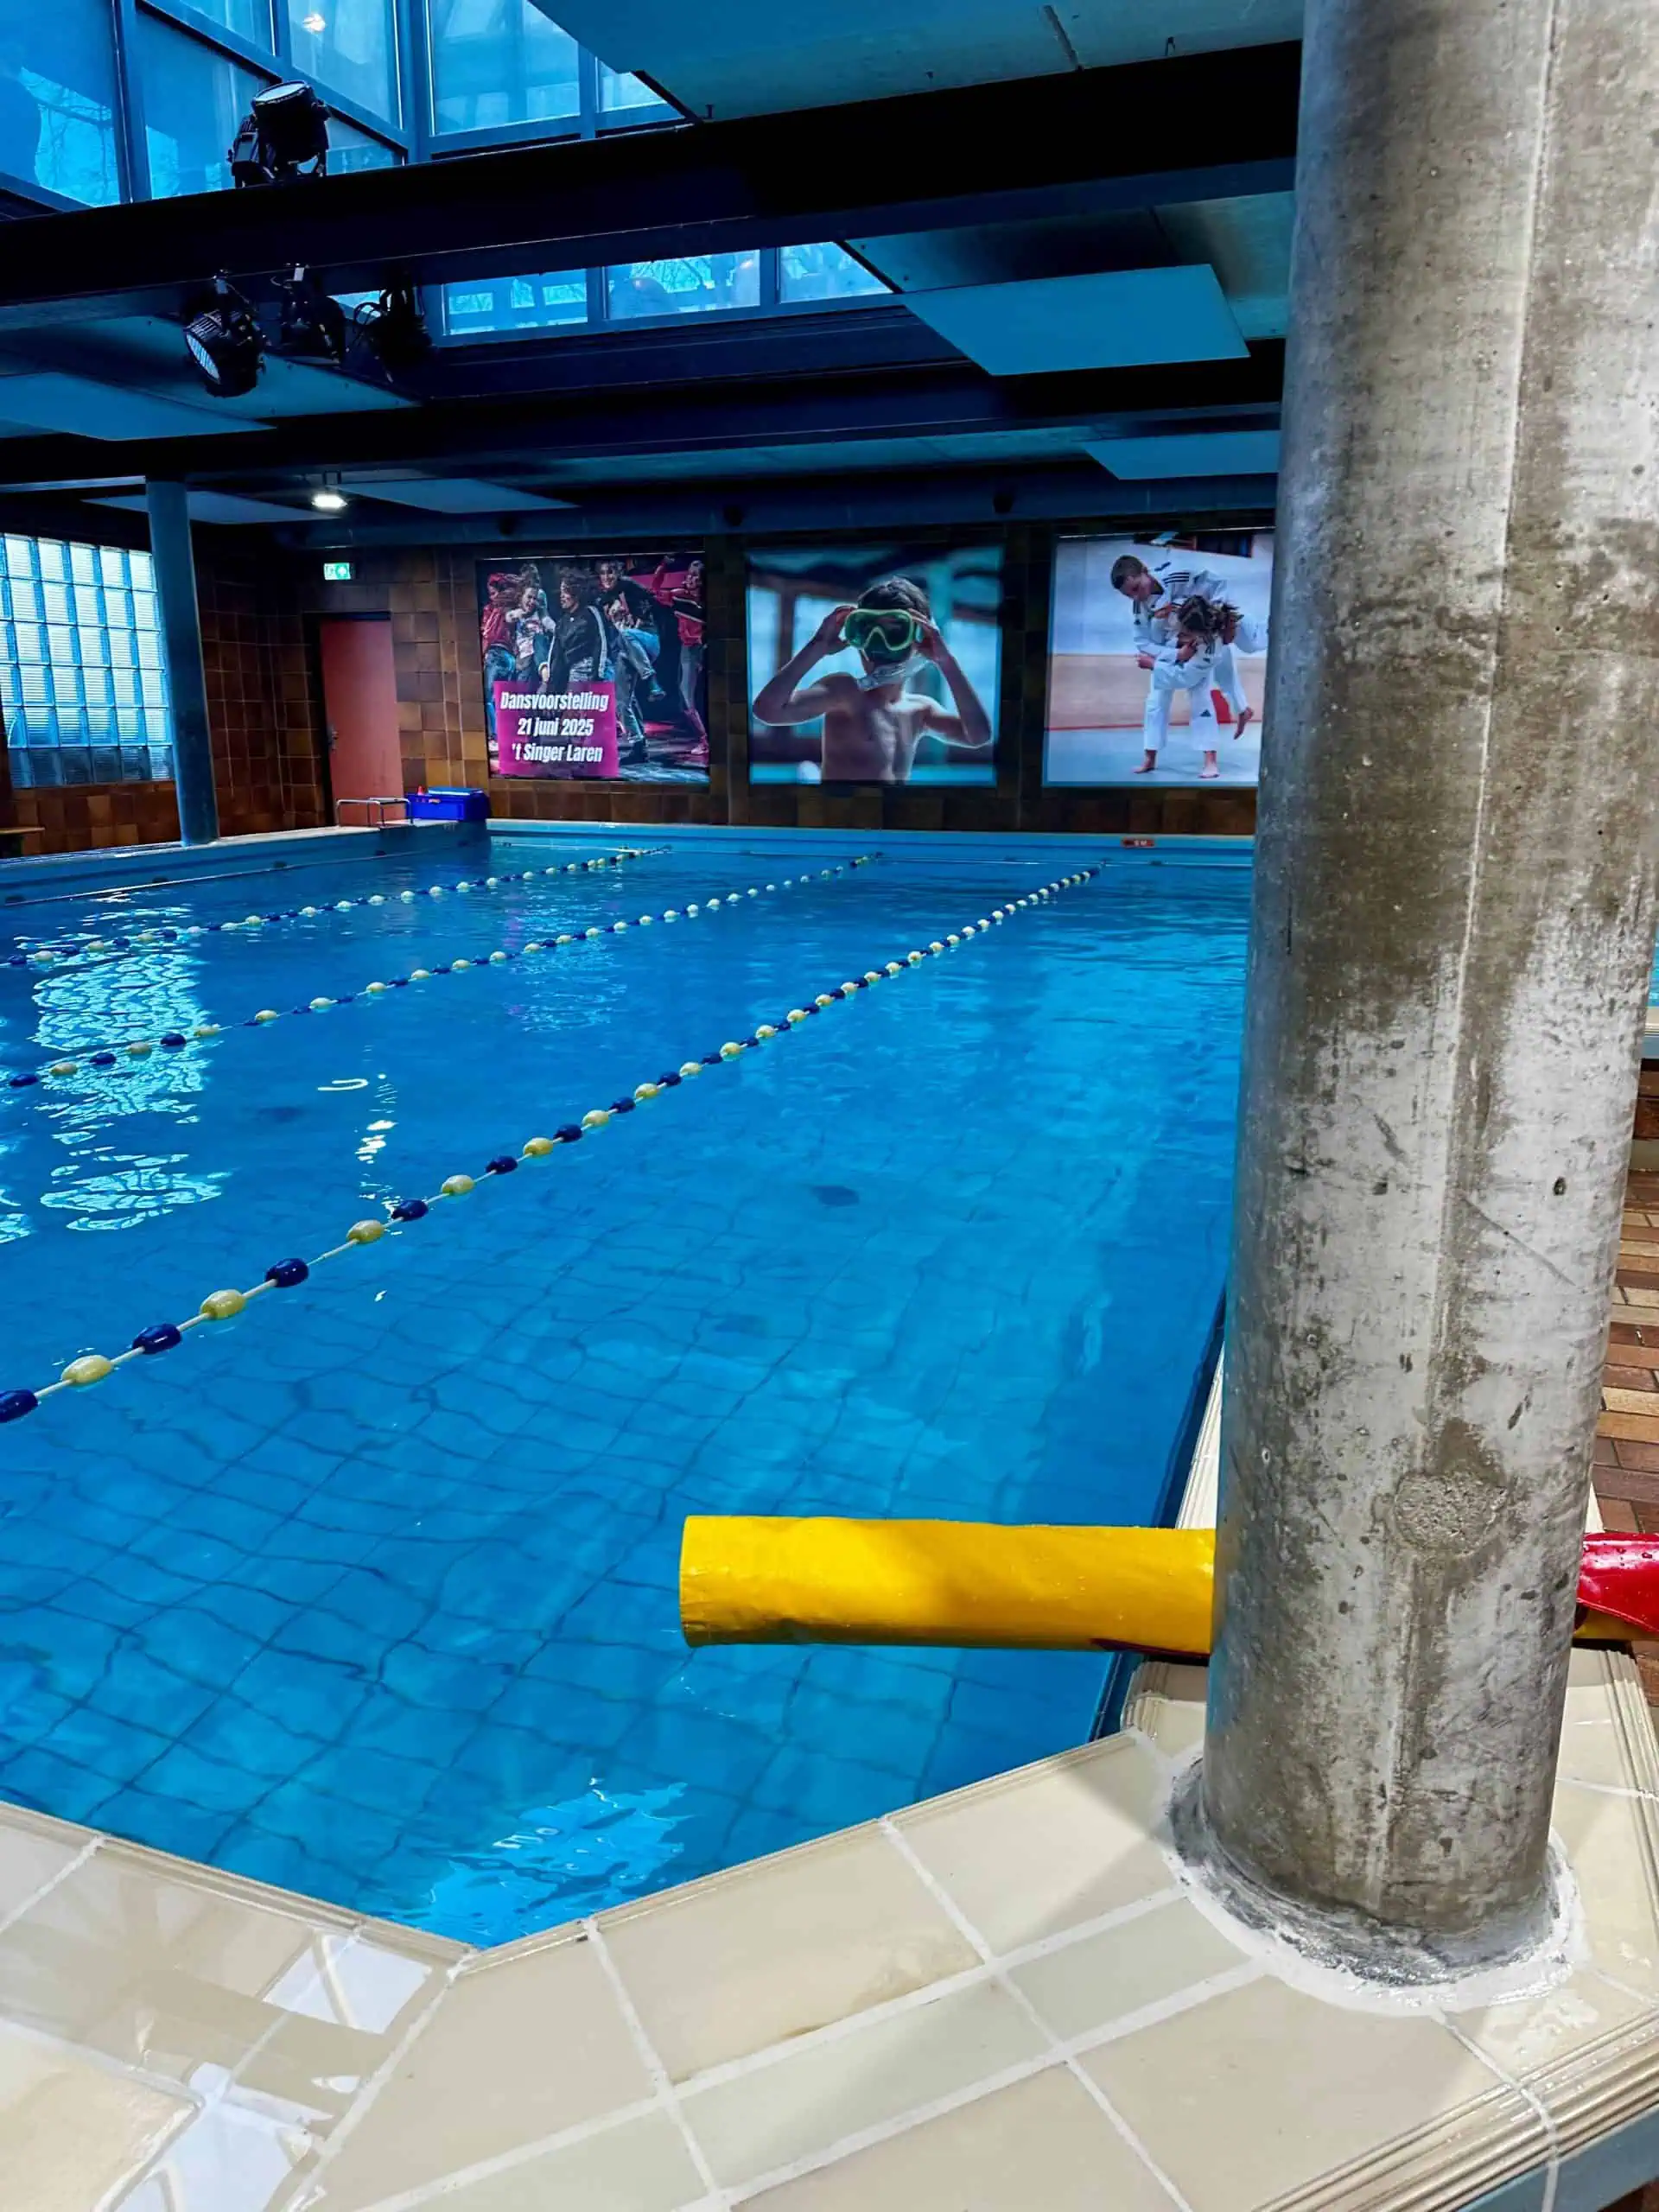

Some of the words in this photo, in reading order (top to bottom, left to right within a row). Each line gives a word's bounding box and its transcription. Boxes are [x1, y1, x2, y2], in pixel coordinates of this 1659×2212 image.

[500, 691, 609, 711] Dansvoorstelling
[518, 718, 532, 735] 21
[533, 717, 559, 736] juni
[561, 718, 594, 735] 2025
[523, 743, 565, 762] Singer
[567, 746, 603, 762] Laren
